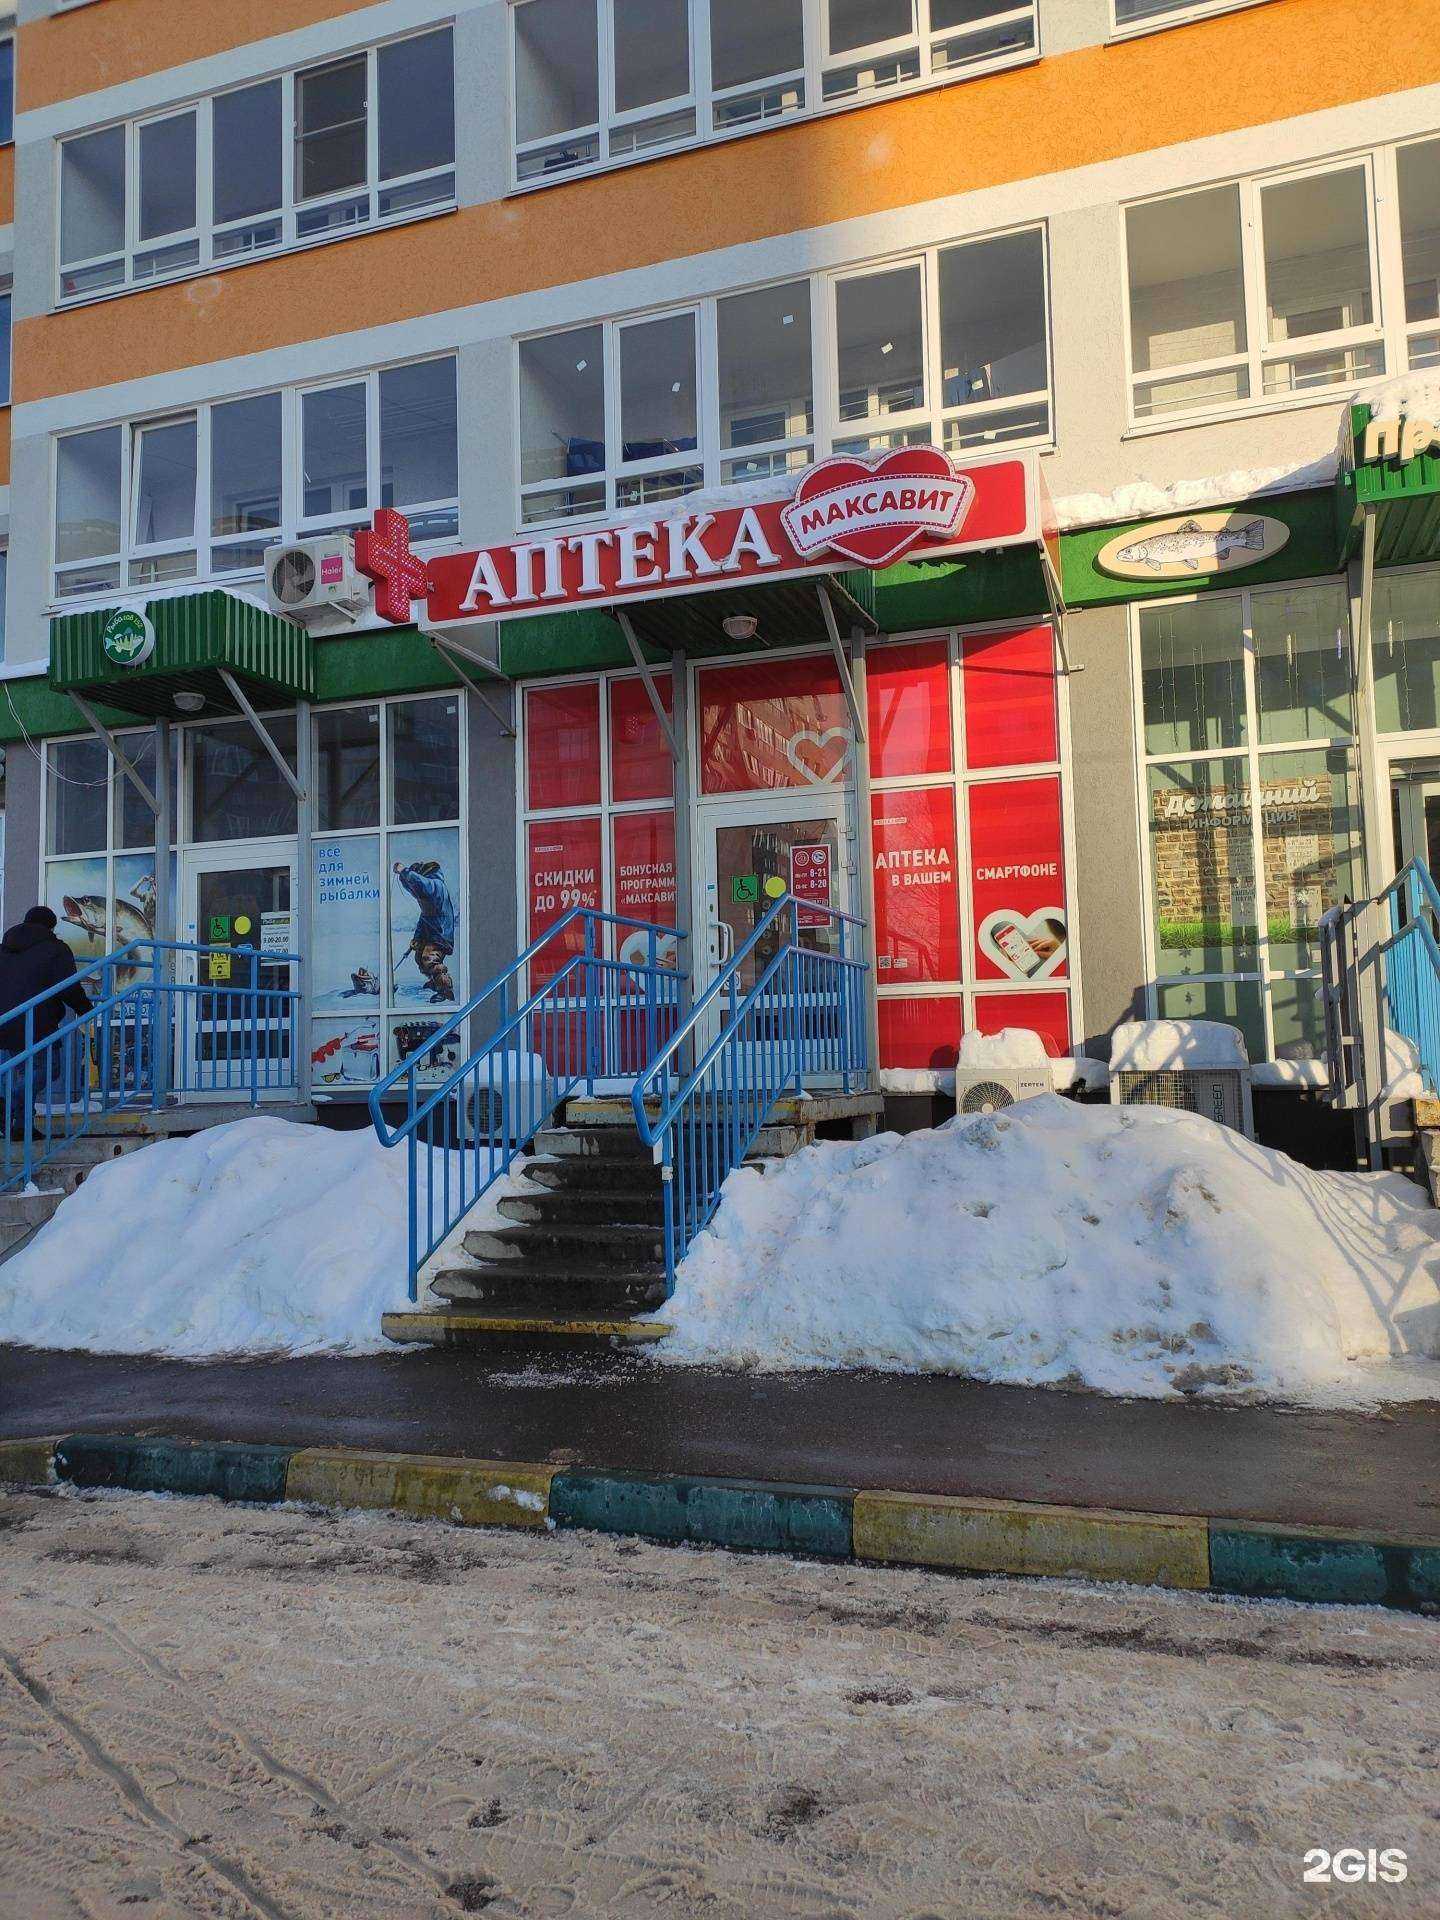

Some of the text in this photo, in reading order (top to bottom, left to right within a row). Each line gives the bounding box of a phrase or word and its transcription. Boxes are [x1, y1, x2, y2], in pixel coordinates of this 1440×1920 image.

[800, 489, 955, 535] МАКСАВИТ
[458, 507, 782, 611] АПТЕКА
[1188, 810, 1297, 829] ИНФОРМЦИЯ
[319, 848, 341, 858] все
[875, 847, 950, 869] АПТЕКА
[319, 862, 344, 874] для
[620, 862, 673, 876] БОНУСНАЯ
[891, 862, 1058, 887] В ВАШЕМ СМАРТФОНЕ
[319, 872, 370, 887] зимней
[534, 868, 595, 887] СКИДКИ
[620, 876, 677, 891] ПРОГРАММ
[320, 888, 380, 904] рыбалки
[534, 895, 555, 912] ДО
